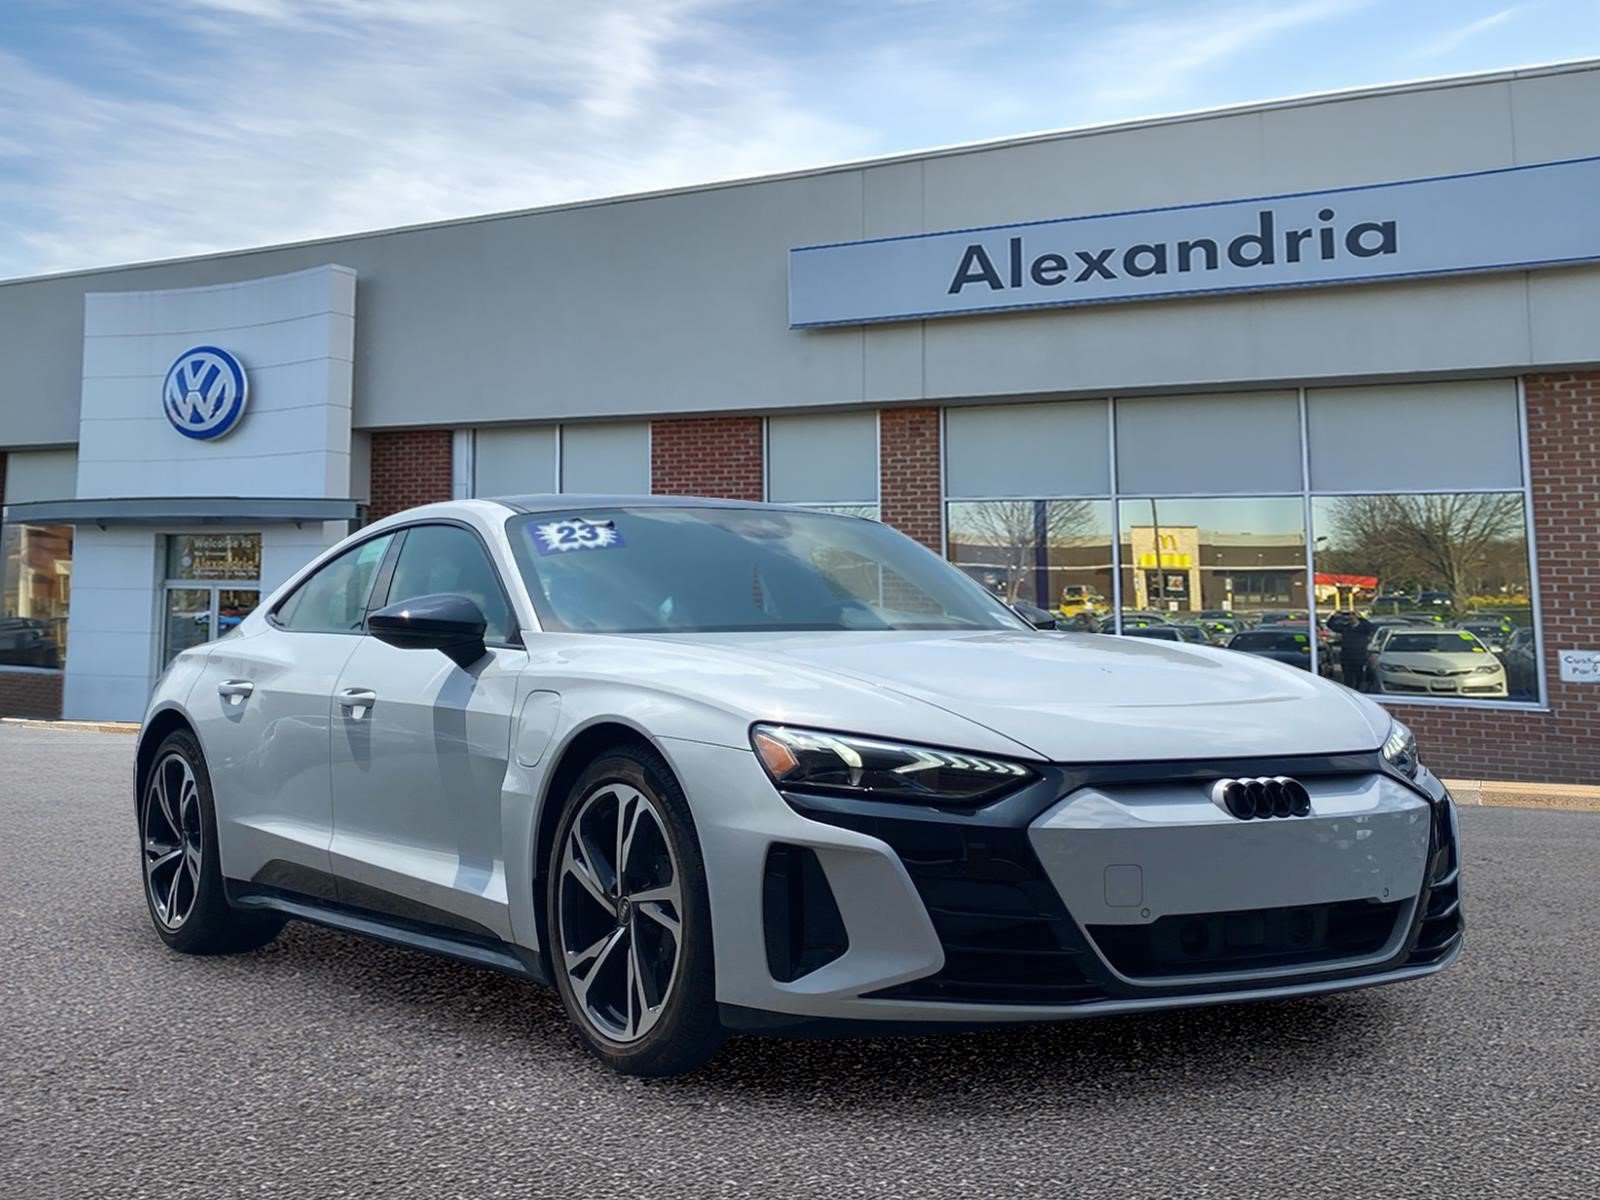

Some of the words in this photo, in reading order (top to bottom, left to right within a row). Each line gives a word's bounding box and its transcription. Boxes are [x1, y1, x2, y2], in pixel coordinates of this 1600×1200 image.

[947, 208, 1398, 295] Alexandria
[167, 353, 235, 430] VW
[556, 525, 599, 543] 23
